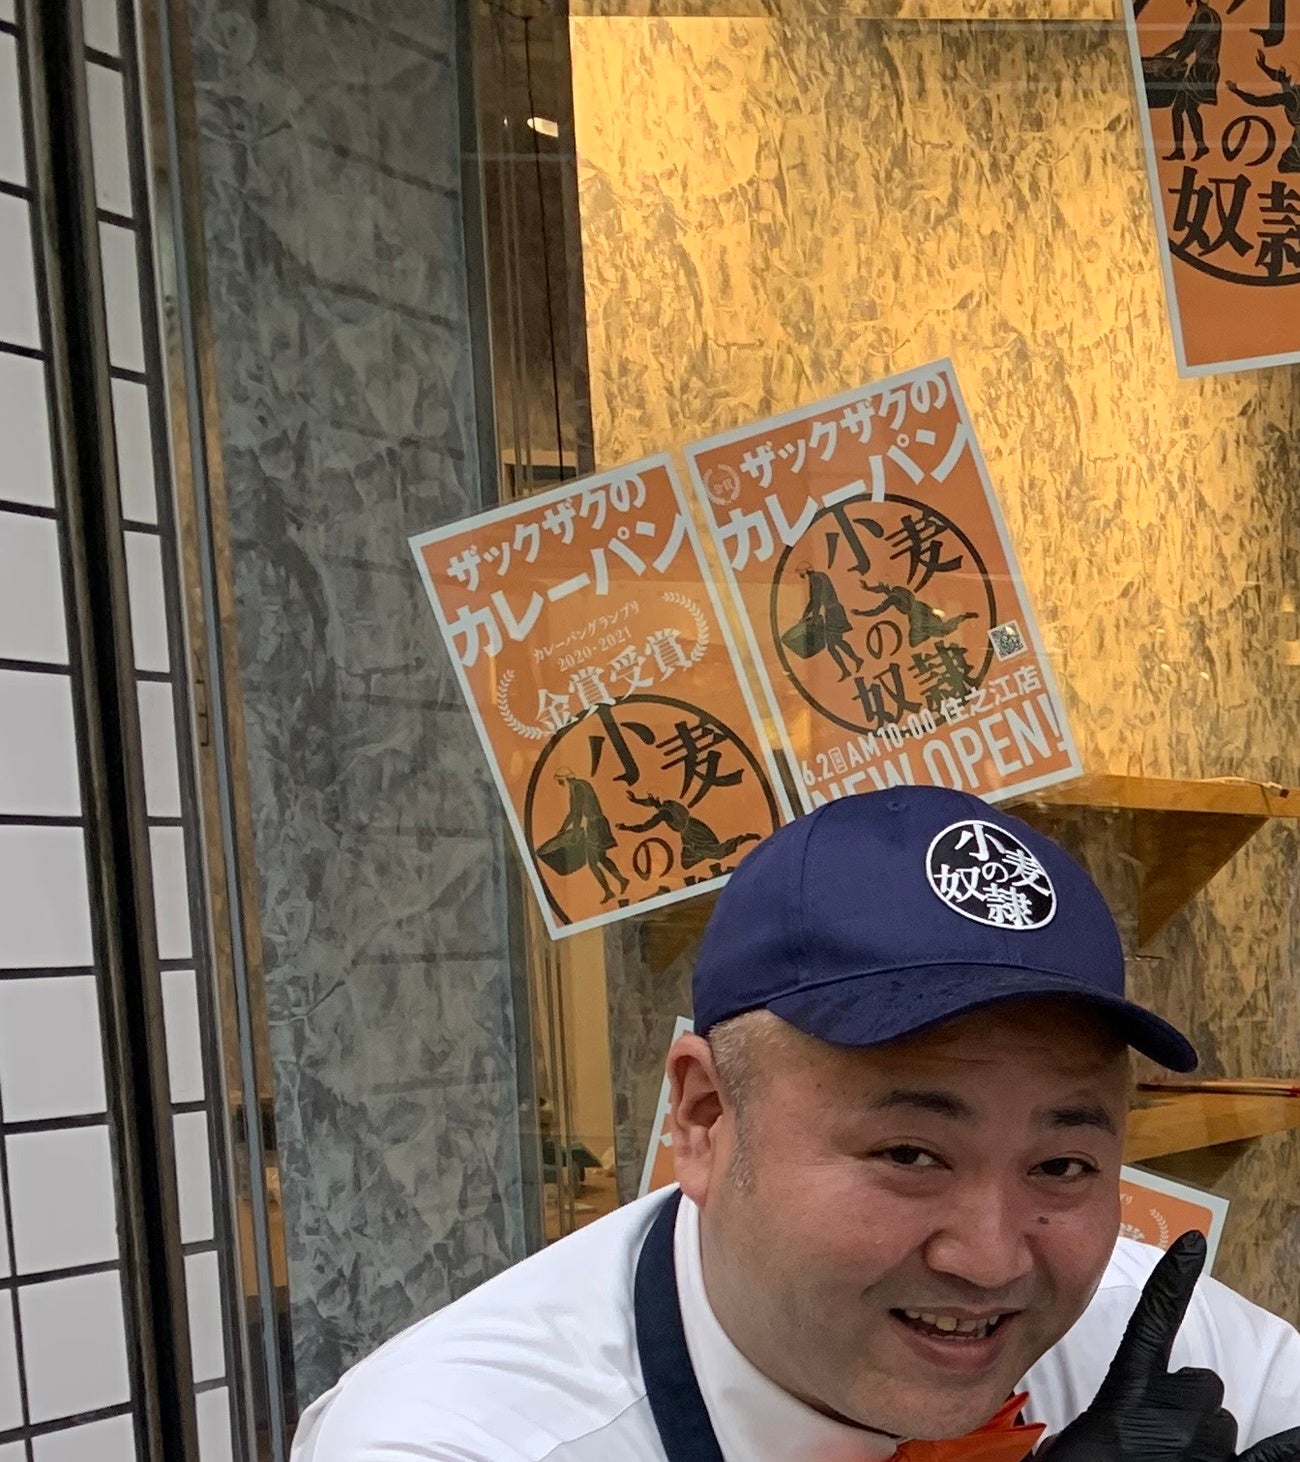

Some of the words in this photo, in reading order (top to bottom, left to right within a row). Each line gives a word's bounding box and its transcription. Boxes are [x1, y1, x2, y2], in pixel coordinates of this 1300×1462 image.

[1222, 115, 1276, 166] の
[739, 369, 947, 491] ザックザクの
[447, 473, 645, 591] ザックザクの
[711, 420, 972, 572] カレーパン
[443, 514, 689, 667] カレーパン
[826, 504, 962, 593] 小麦
[533, 600, 639, 664] カレーパングランプリ
[867, 620, 901, 658] の
[537, 627, 692, 733] 金賞受賞
[801, 752, 832, 786] 6.2
[846, 708, 936, 769] AM10:00
[941, 665, 1041, 724] 住之江店
[591, 703, 744, 808] 小麦
[923, 694, 1066, 791] OPEN!
[633, 838, 673, 879] の
[934, 864, 1033, 925] 奴隷
[955, 824, 1050, 896] 小麦
[982, 863, 1008, 882] の
